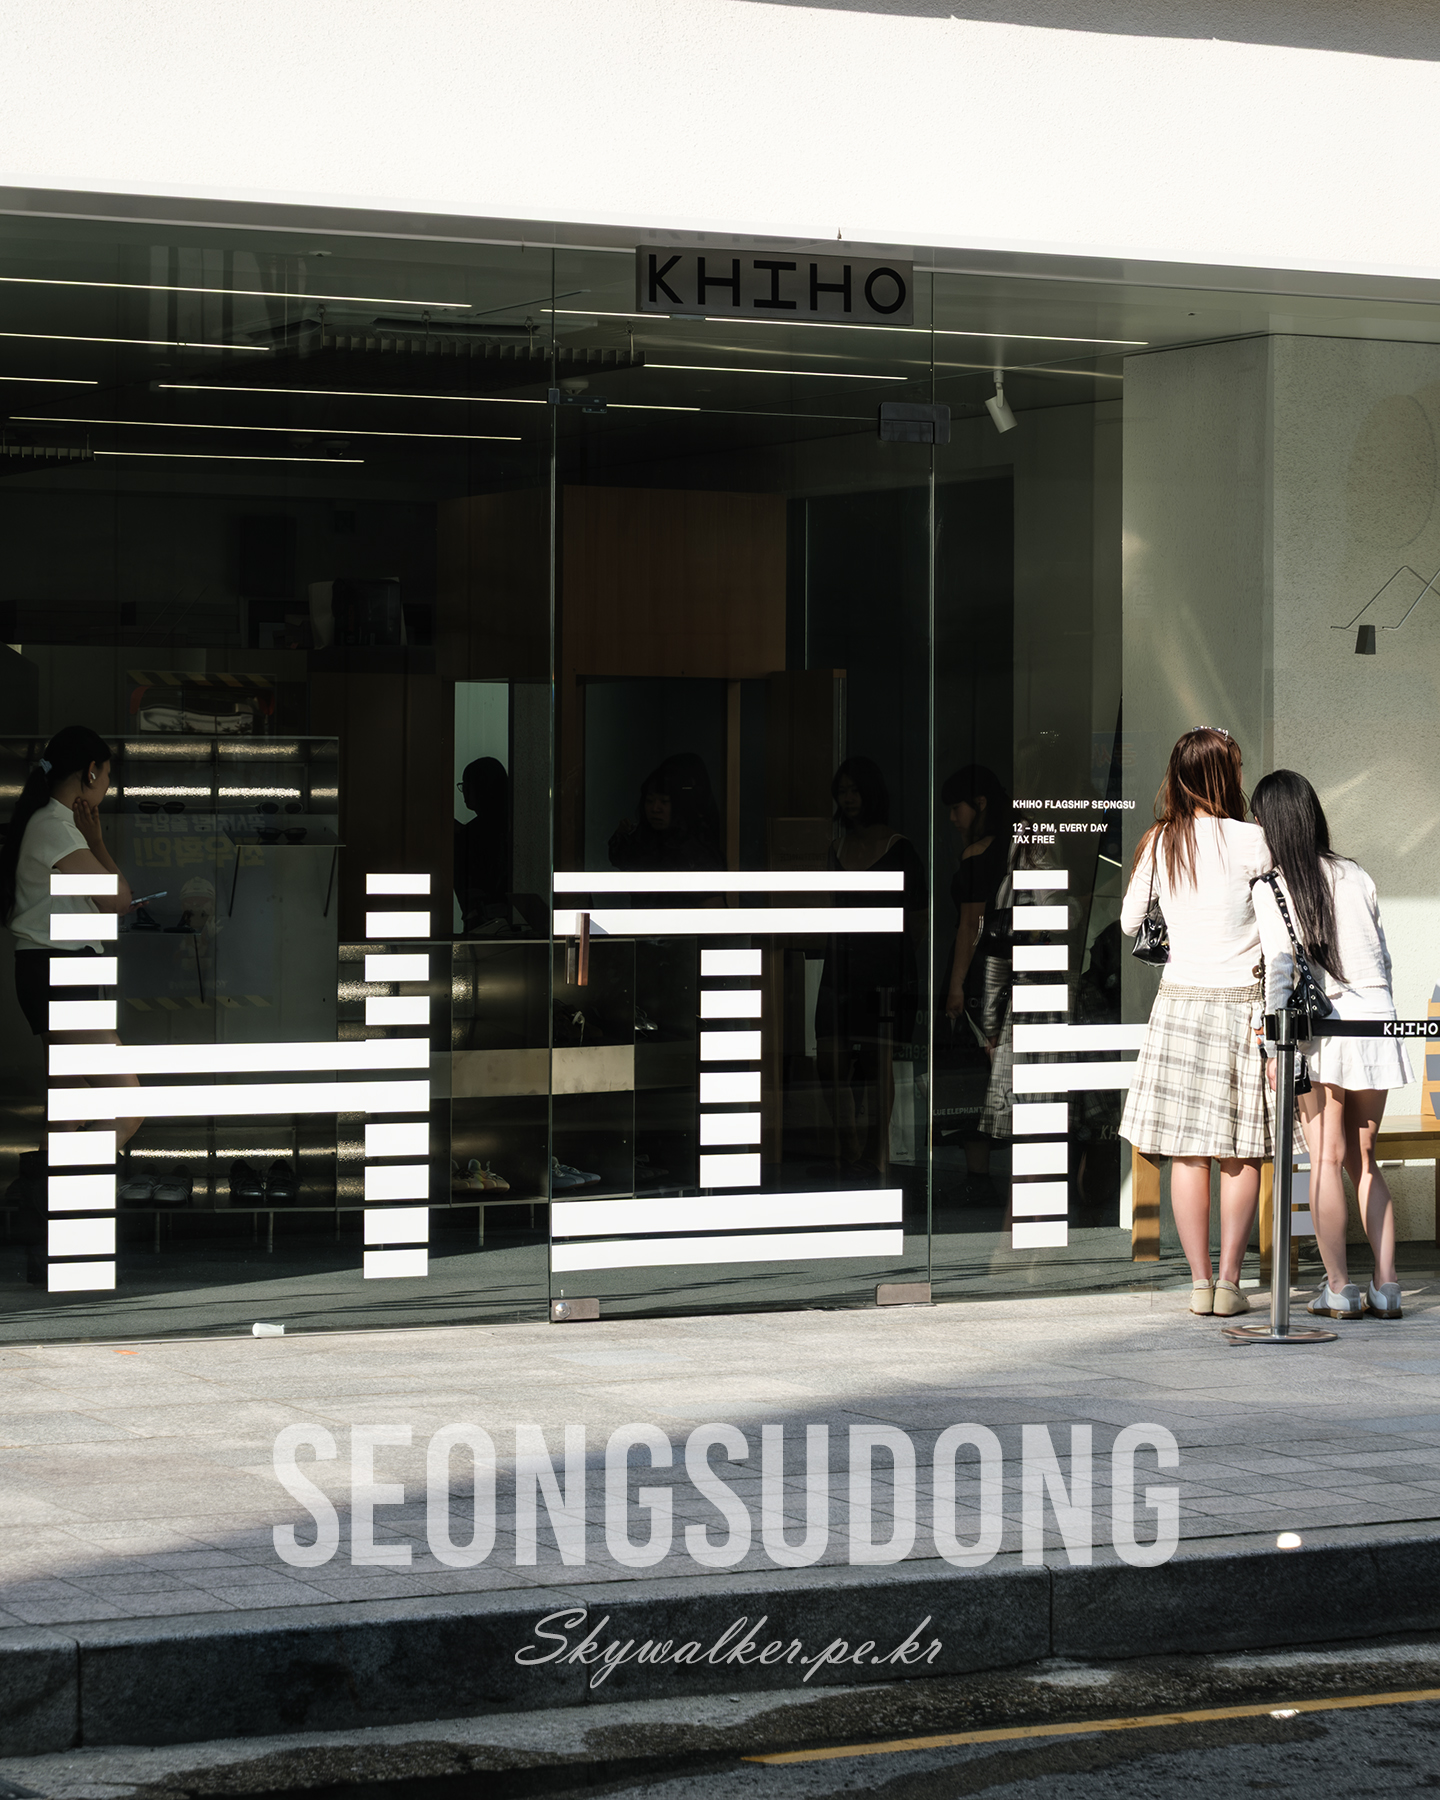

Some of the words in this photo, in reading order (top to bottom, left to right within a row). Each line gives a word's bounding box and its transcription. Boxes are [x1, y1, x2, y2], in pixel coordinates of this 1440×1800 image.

[648, 253, 906, 315] KHIHO
[1012, 800, 1043, 809] KHIHO
[1045, 800, 1090, 809] FLAGSHIP
[1092, 800, 1136, 810] SEONGSU
[1013, 823, 1023, 833] 12
[1032, 823, 1039, 833] 9
[1040, 823, 1057, 834] PM,
[1060, 823, 1089, 833] EVERY
[1090, 823, 1109, 833] DAY
[1012, 835, 1030, 844] TAX
[1032, 835, 1055, 844] FREE
[1383, 1022, 1439, 1036] KHIHO
[932, 1108, 946, 1116] LUE
[947, 1106, 984, 1116] ELEPHANT
